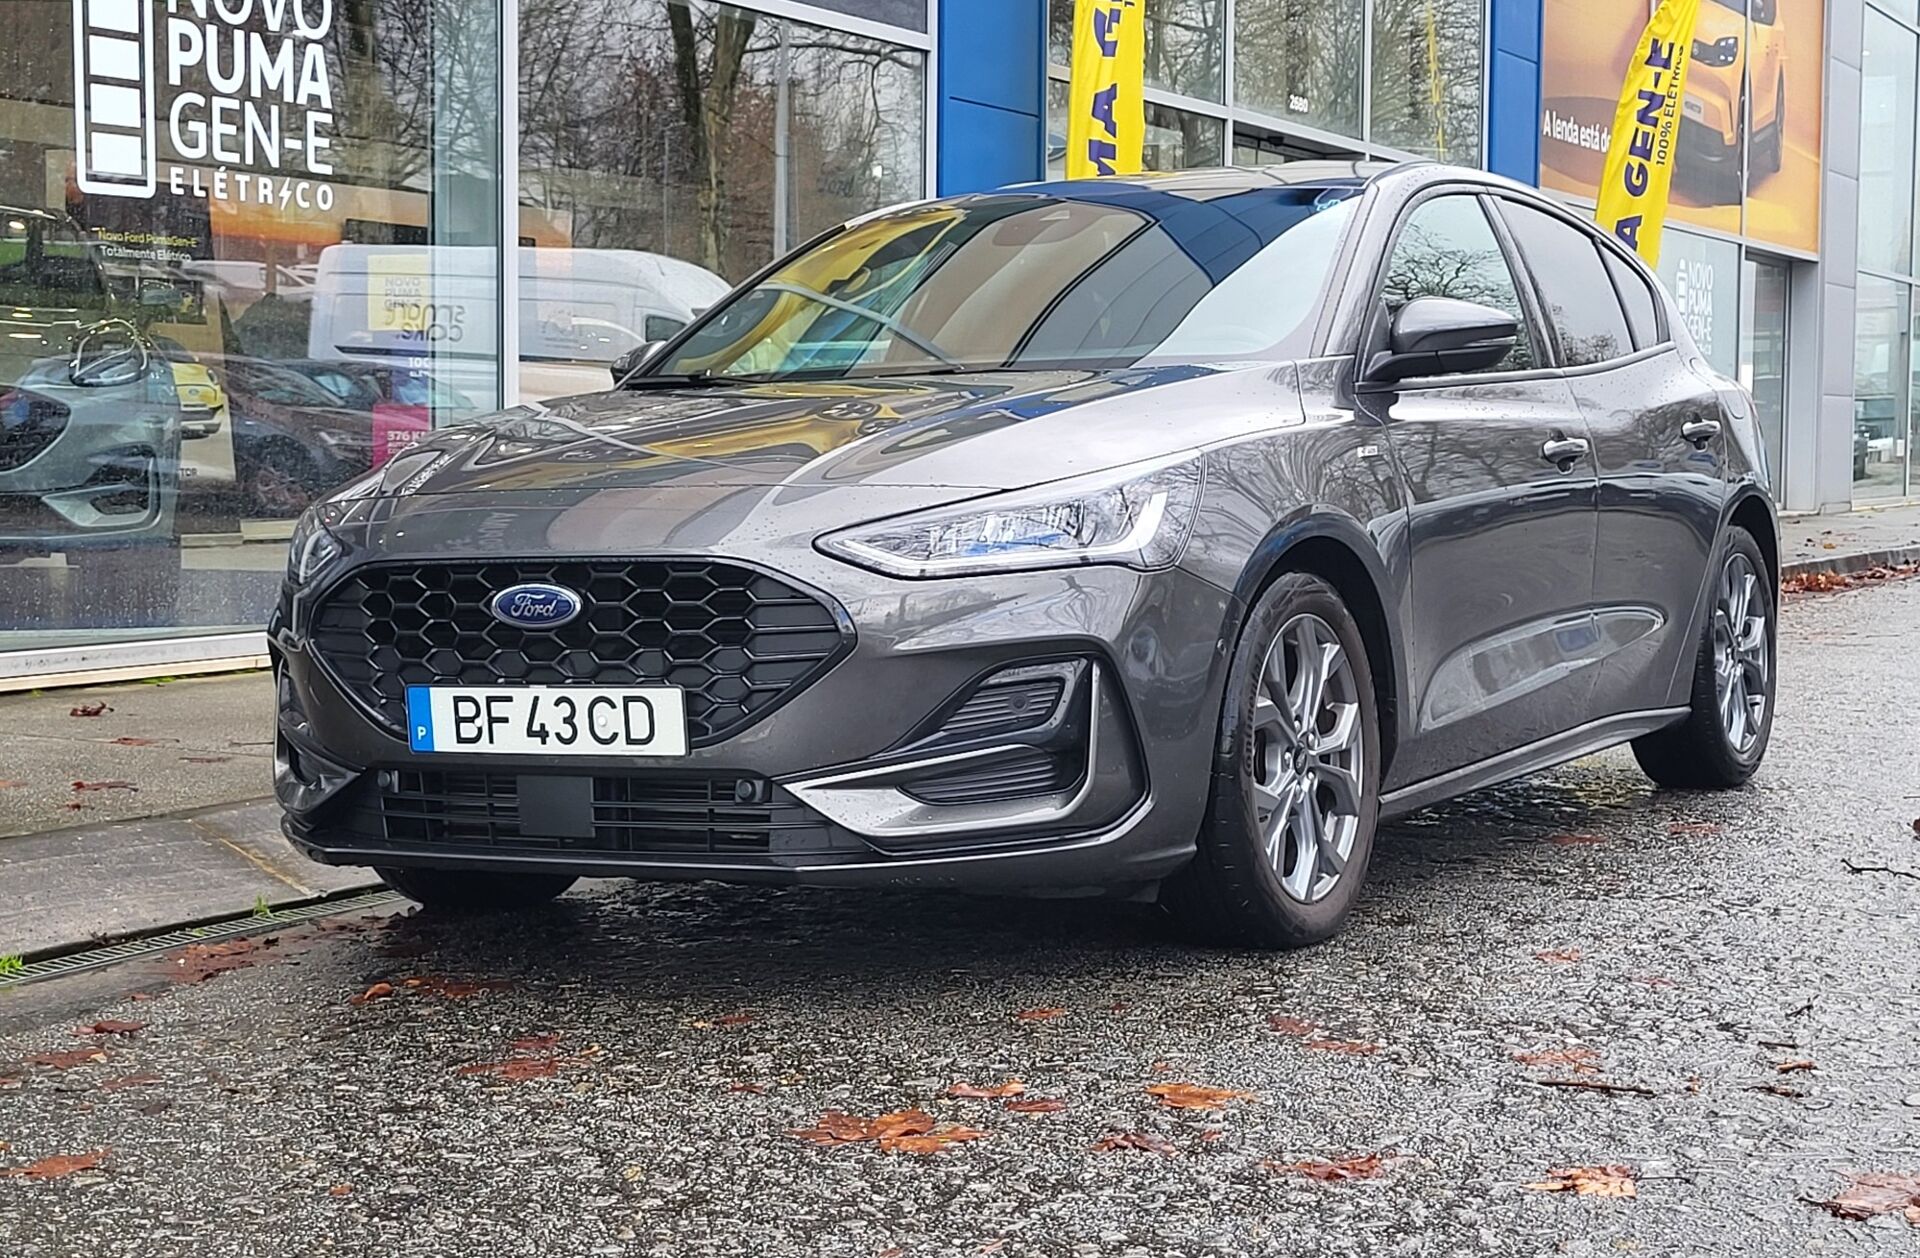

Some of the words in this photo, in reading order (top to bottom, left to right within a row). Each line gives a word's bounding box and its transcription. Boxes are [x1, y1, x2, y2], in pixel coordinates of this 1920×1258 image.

[167, 16, 333, 109] PUMA
[1543, 109, 1552, 137] A
[1552, 111, 1579, 145] lenda
[1580, 123, 1600, 151] está
[1624, 38, 1675, 197] GEN-E
[169, 91, 333, 175] GEN-E
[1656, 120, 1673, 165] 100%
[98, 229, 123, 241] Novo
[124, 232, 145, 243] Ford
[100, 245, 156, 260] Totalmente
[384, 276, 422, 287] NOVO
[1688, 261, 1714, 291] NOVO
[1688, 287, 1713, 316] PUMA
[387, 431, 410, 441] 376
[511, 593, 558, 617] Ford
[417, 726, 427, 741] P
[452, 695, 514, 745] BF
[526, 695, 579, 746] 43
[587, 696, 656, 746] CD
